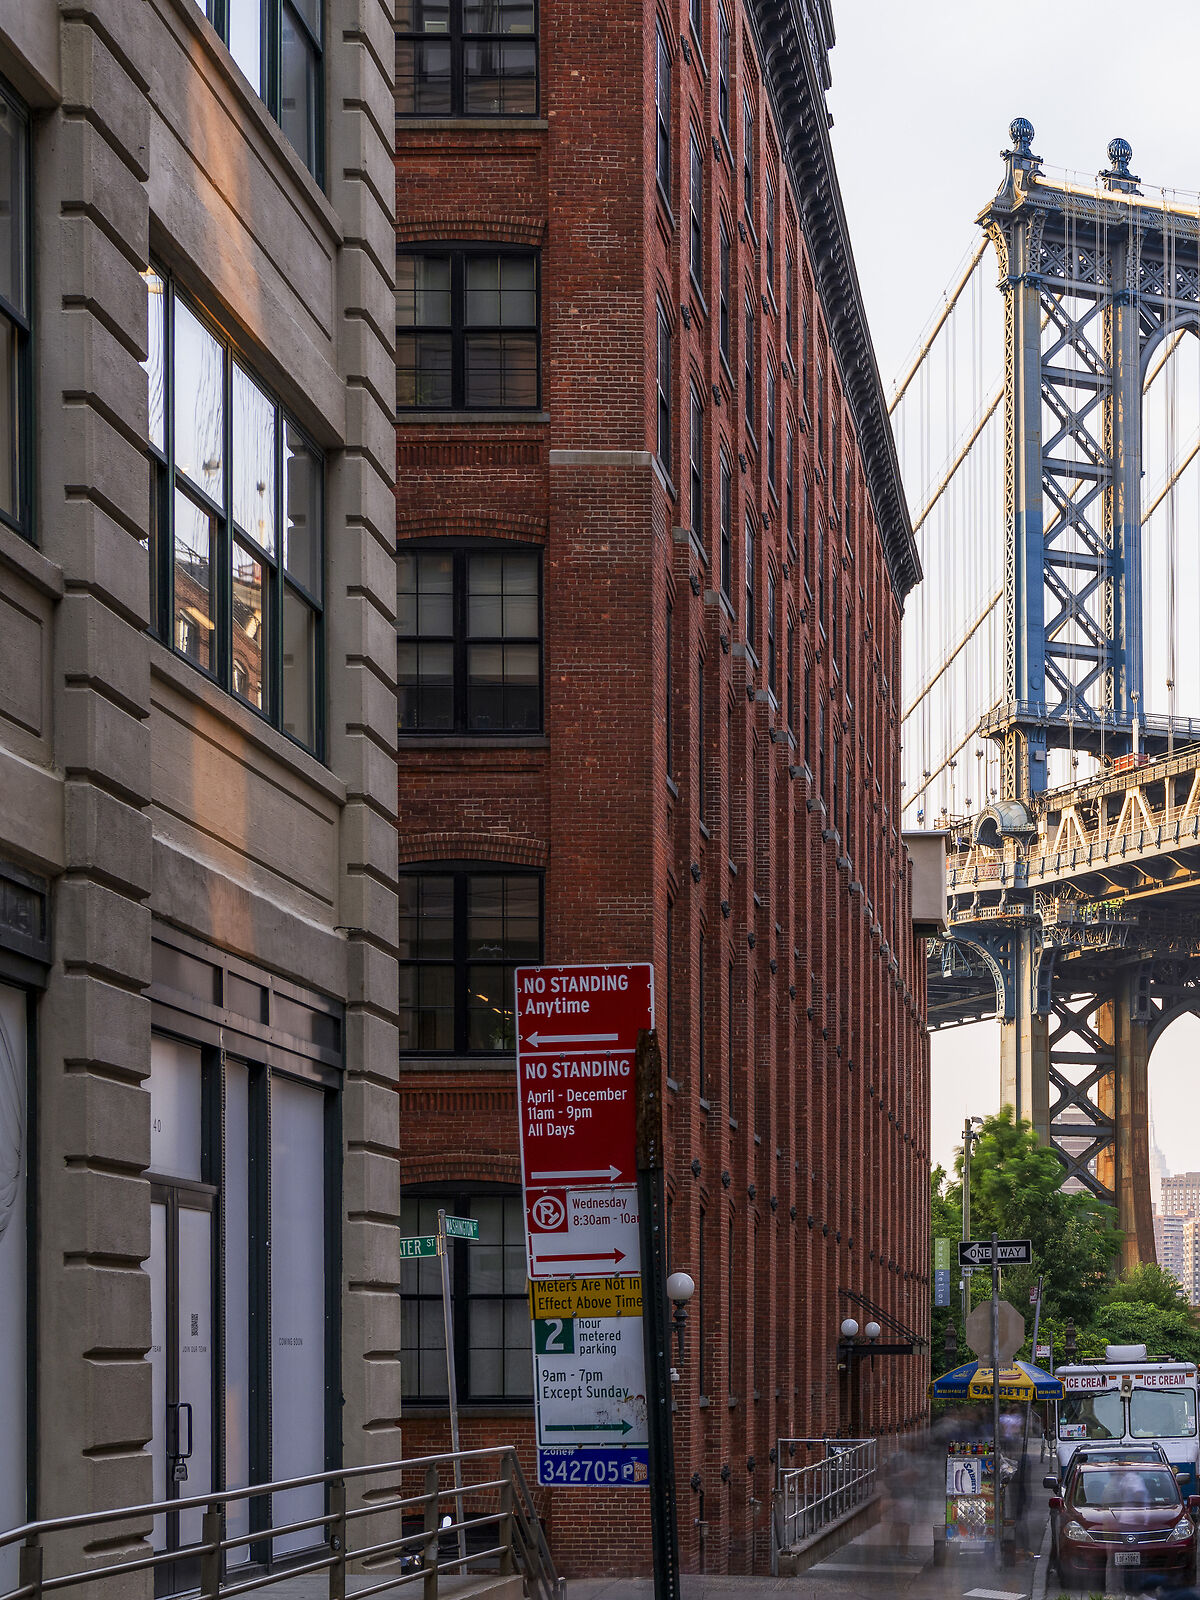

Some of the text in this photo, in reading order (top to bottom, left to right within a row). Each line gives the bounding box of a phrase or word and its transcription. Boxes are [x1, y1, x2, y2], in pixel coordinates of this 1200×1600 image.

[524, 974, 629, 993] NO STANDING
[525, 997, 590, 1017] Anytime
[525, 1060, 630, 1079] NO STANDING
[527, 1089, 555, 1104] April
[566, 1087, 628, 1102] December
[527, 1106, 555, 1120] 11am
[566, 1105, 593, 1121] 9pm
[528, 1122, 575, 1139] All Days
[572, 1197, 628, 1209] Wednesday
[573, 1214, 611, 1226] 8:30am
[426, 1238, 435, 1248] ST
[970, 1247, 1022, 1258] ONE WAY
[537, 1277, 640, 1292] Meters Are Not In
[538, 1297, 573, 1310] Effect
[576, 1296, 612, 1309] Above
[545, 1318, 602, 1351] 2 hour
[579, 1331, 622, 1342] metered
[579, 1343, 617, 1356] parking
[542, 1370, 567, 1383] 9am
[579, 1369, 603, 1384] 7pm
[1066, 1378, 1079, 1388] ICE
[1143, 1374, 1186, 1386] ICE CREAM
[543, 1385, 630, 1400] Except Sunday
[543, 1460, 619, 1482] 342705
